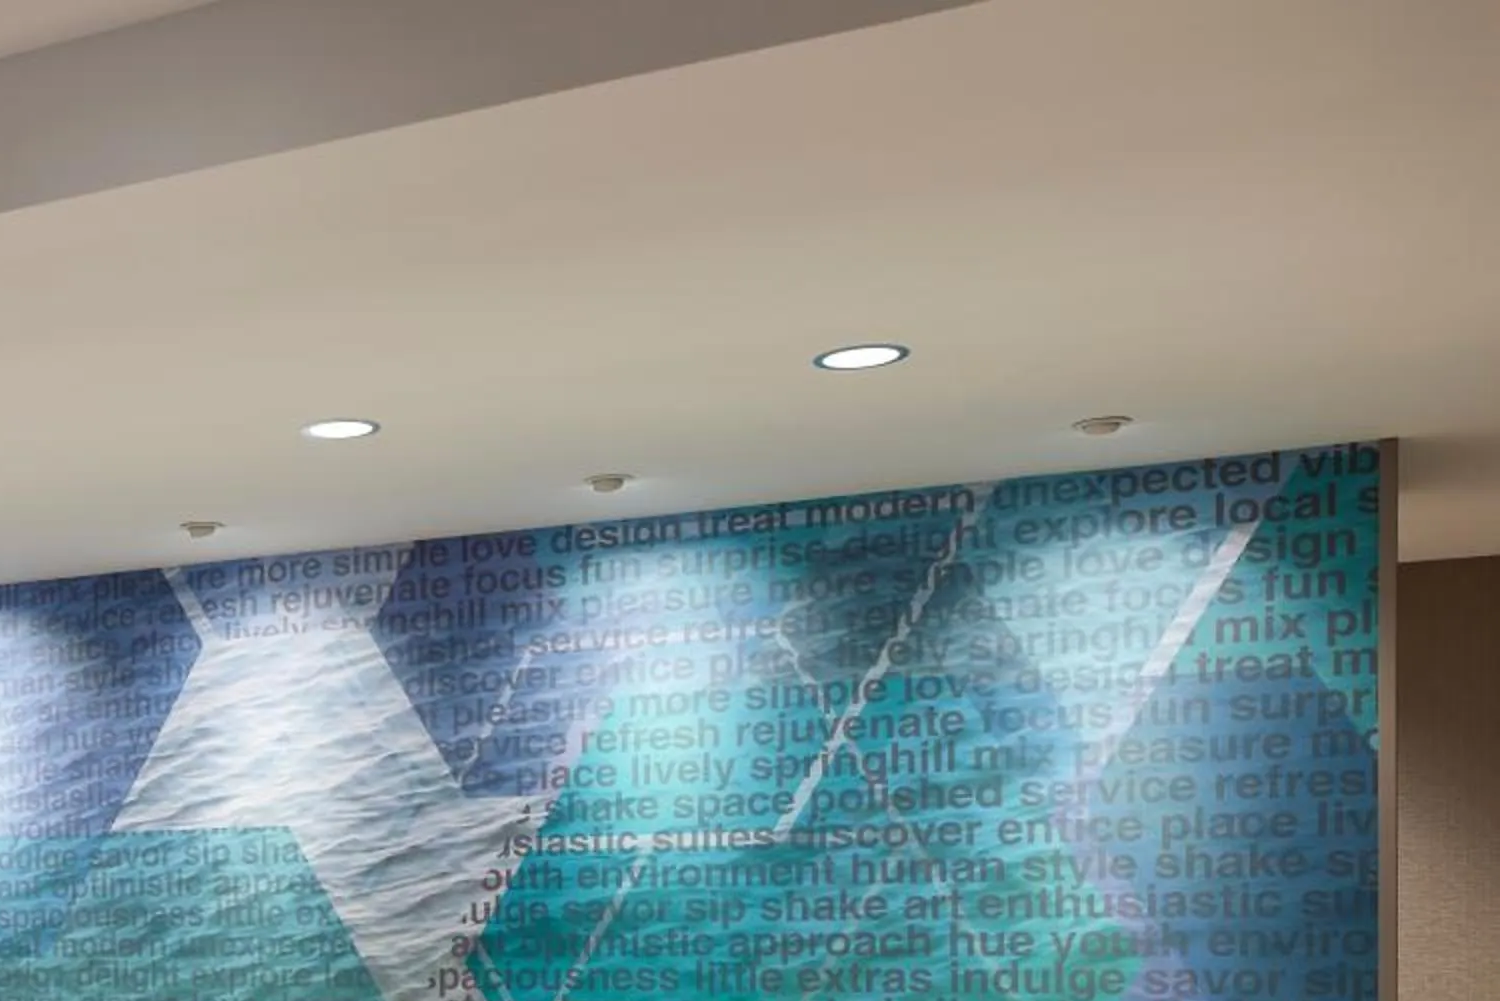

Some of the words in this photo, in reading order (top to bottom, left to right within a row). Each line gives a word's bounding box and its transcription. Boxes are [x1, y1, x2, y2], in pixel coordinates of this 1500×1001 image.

[239, 557, 321, 585] more
[332, 542, 449, 576] simple
[462, 535, 536, 562] love
[550, 519, 680, 554] design
[699, 504, 790, 539] treat
[806, 489, 974, 528] modern
[992, 453, 1279, 509] unexpected
[1300, 443, 1379, 479] vib
[29, 604, 134, 635] service
[271, 574, 450, 616] rejuvenate
[464, 565, 566, 595] focus
[580, 556, 638, 584] fun
[657, 538, 826, 578] surprise
[843, 518, 995, 560] delight
[1013, 504, 1197, 547] explore
[1216, 483, 1336, 526] local
[33, 635, 119, 664] entice
[501, 594, 566, 625] mix
[582, 582, 753, 625] pleasure
[769, 572, 873, 602] more
[1062, 545, 1171, 578] love
[528, 621, 667, 656] service
[684, 604, 827, 644] refresh
[1104, 578, 1244, 612] focs
[1268, 567, 1345, 600] fun
[405, 666, 563, 697] discover
[575, 653, 694, 686] entice
[1216, 607, 1306, 643] mix
[453, 696, 614, 733] pleasure
[629, 689, 730, 716] more
[745, 674, 887, 712] simple
[904, 670, 996, 700] love
[1194, 646, 1314, 683] treat
[581, 718, 719, 753] refresh
[736, 707, 964, 750] rejuvenate
[983, 702, 1112, 732] focus
[515, 761, 617, 796] place
[632, 753, 733, 788] lively
[749, 741, 954, 785] springhill
[975, 737, 1054, 770] mix
[546, 791, 658, 821] shake
[673, 791, 793, 823] space
[812, 776, 1002, 819] polished
[1021, 770, 1197, 805] service
[90, 846, 169, 867] savor
[184, 839, 229, 870] sip
[652, 822, 774, 852] suites
[789, 819, 981, 848] discover
[998, 810, 1142, 843] entice
[1162, 806, 1297, 846] place
[577, 856, 836, 888] environment
[852, 853, 1004, 883] human
[1022, 847, 1137, 886] style
[1154, 843, 1306, 877] shake
[562, 899, 667, 922] savor
[685, 892, 743, 927] sip
[760, 889, 887, 919] shake
[904, 890, 964, 918] art
[979, 883, 1284, 917] enthusiastic
[729, 925, 929, 962] approach
[950, 924, 1035, 954] hue
[1052, 923, 1189, 962] youth
[696, 961, 781, 990] little
[796, 963, 931, 991] extras
[950, 961, 1124, 999] indulge
[1143, 969, 1284, 993] savor
